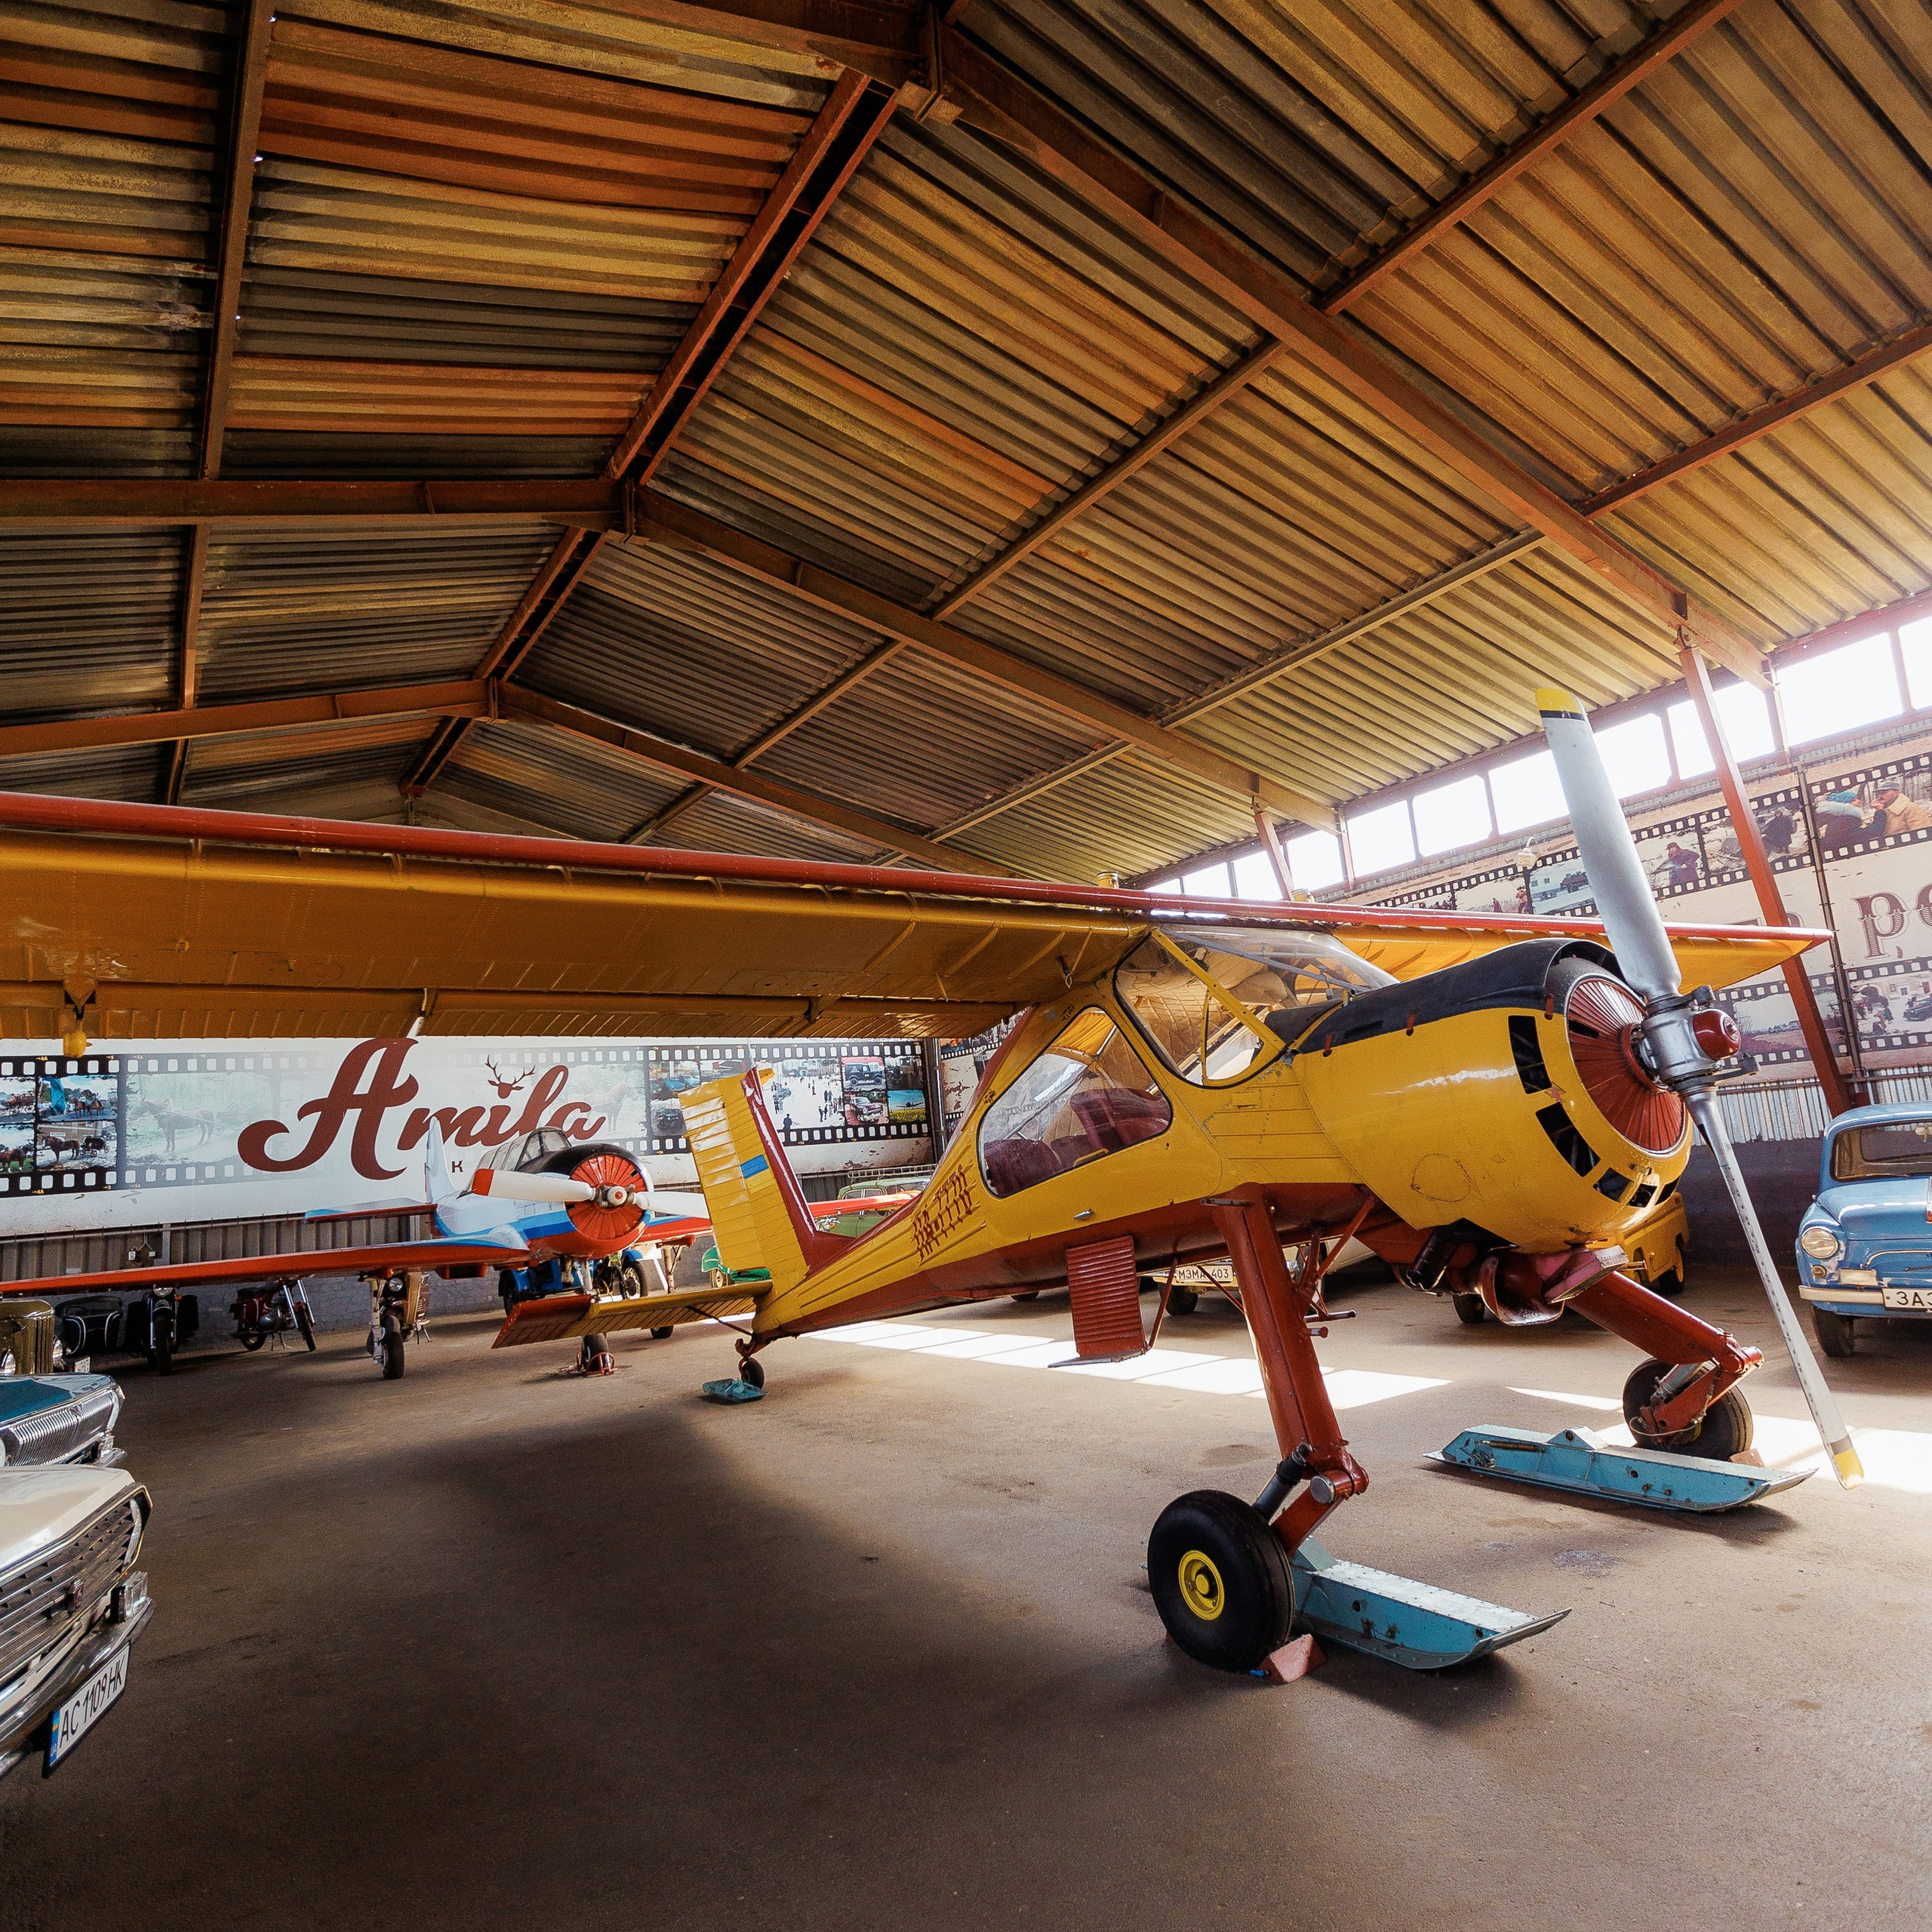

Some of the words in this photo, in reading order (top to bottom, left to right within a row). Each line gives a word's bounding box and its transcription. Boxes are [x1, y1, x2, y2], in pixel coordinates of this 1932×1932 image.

[237, 1038, 606, 1180] Amila
[82, 1672, 107, 1724] 1109
[107, 1654, 126, 1699] HK
